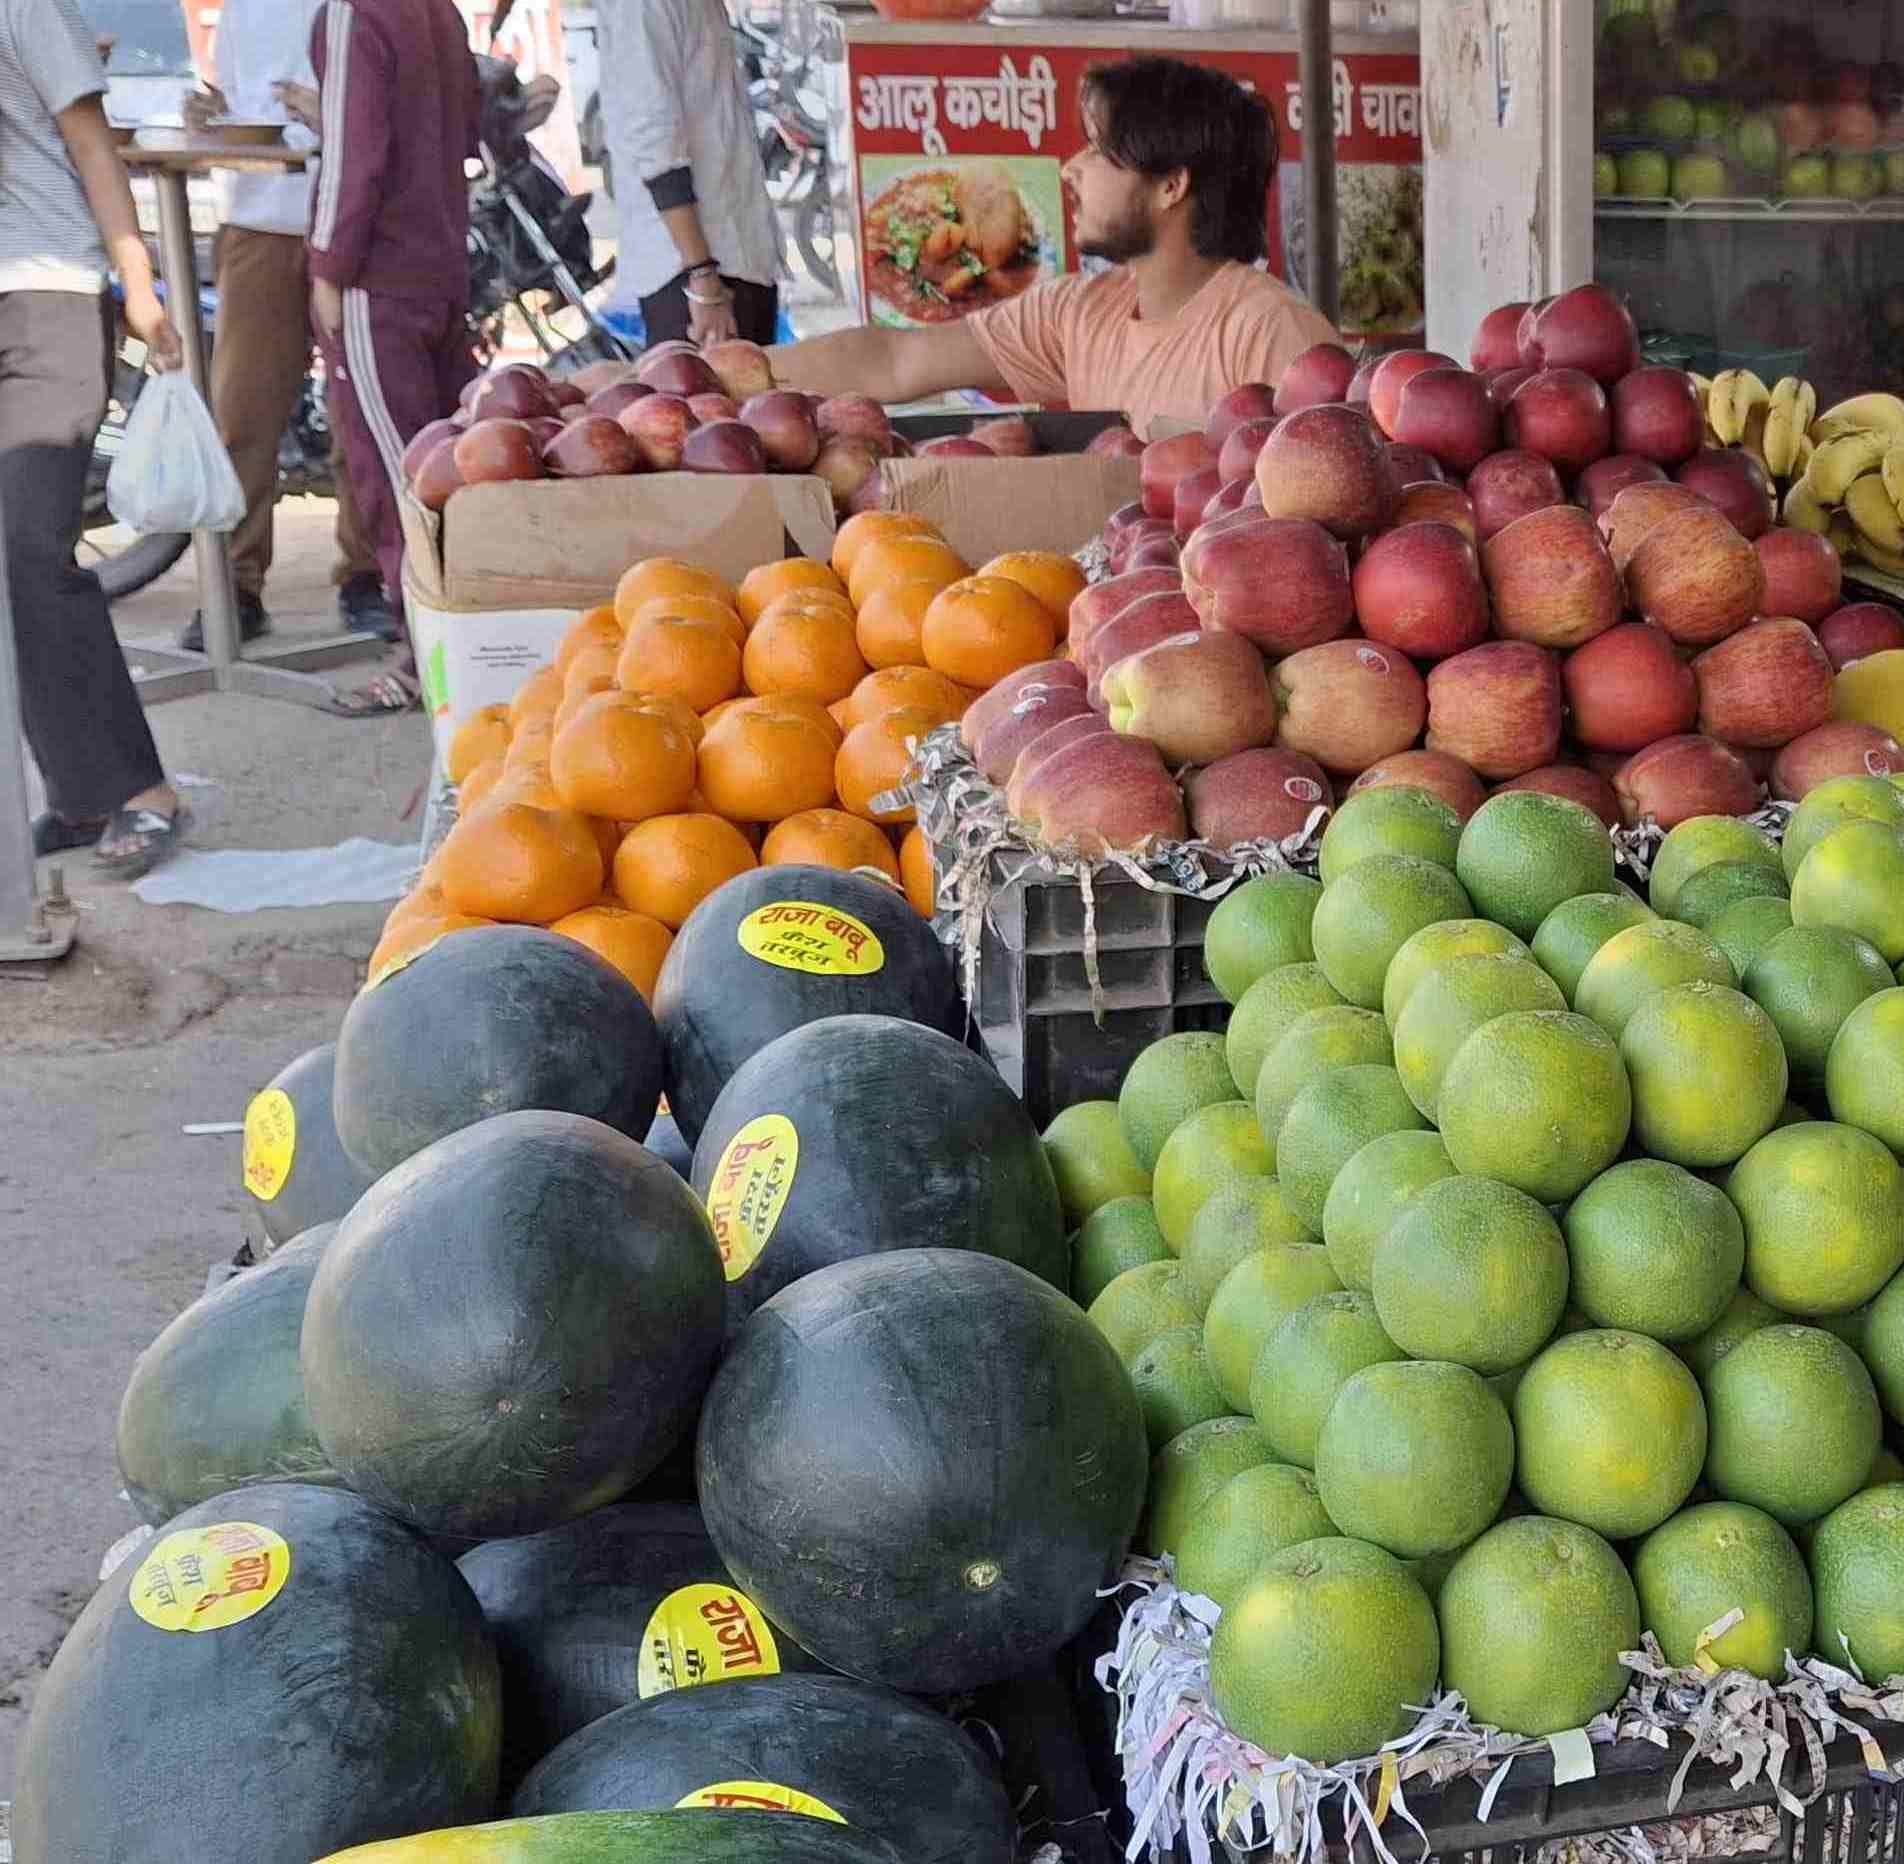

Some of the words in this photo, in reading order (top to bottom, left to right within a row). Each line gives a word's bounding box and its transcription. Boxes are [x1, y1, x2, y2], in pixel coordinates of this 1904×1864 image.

[857, 75, 949, 155] आलू
[759, 907, 823, 926] राजा
[700, 1595, 762, 1668] राजा
